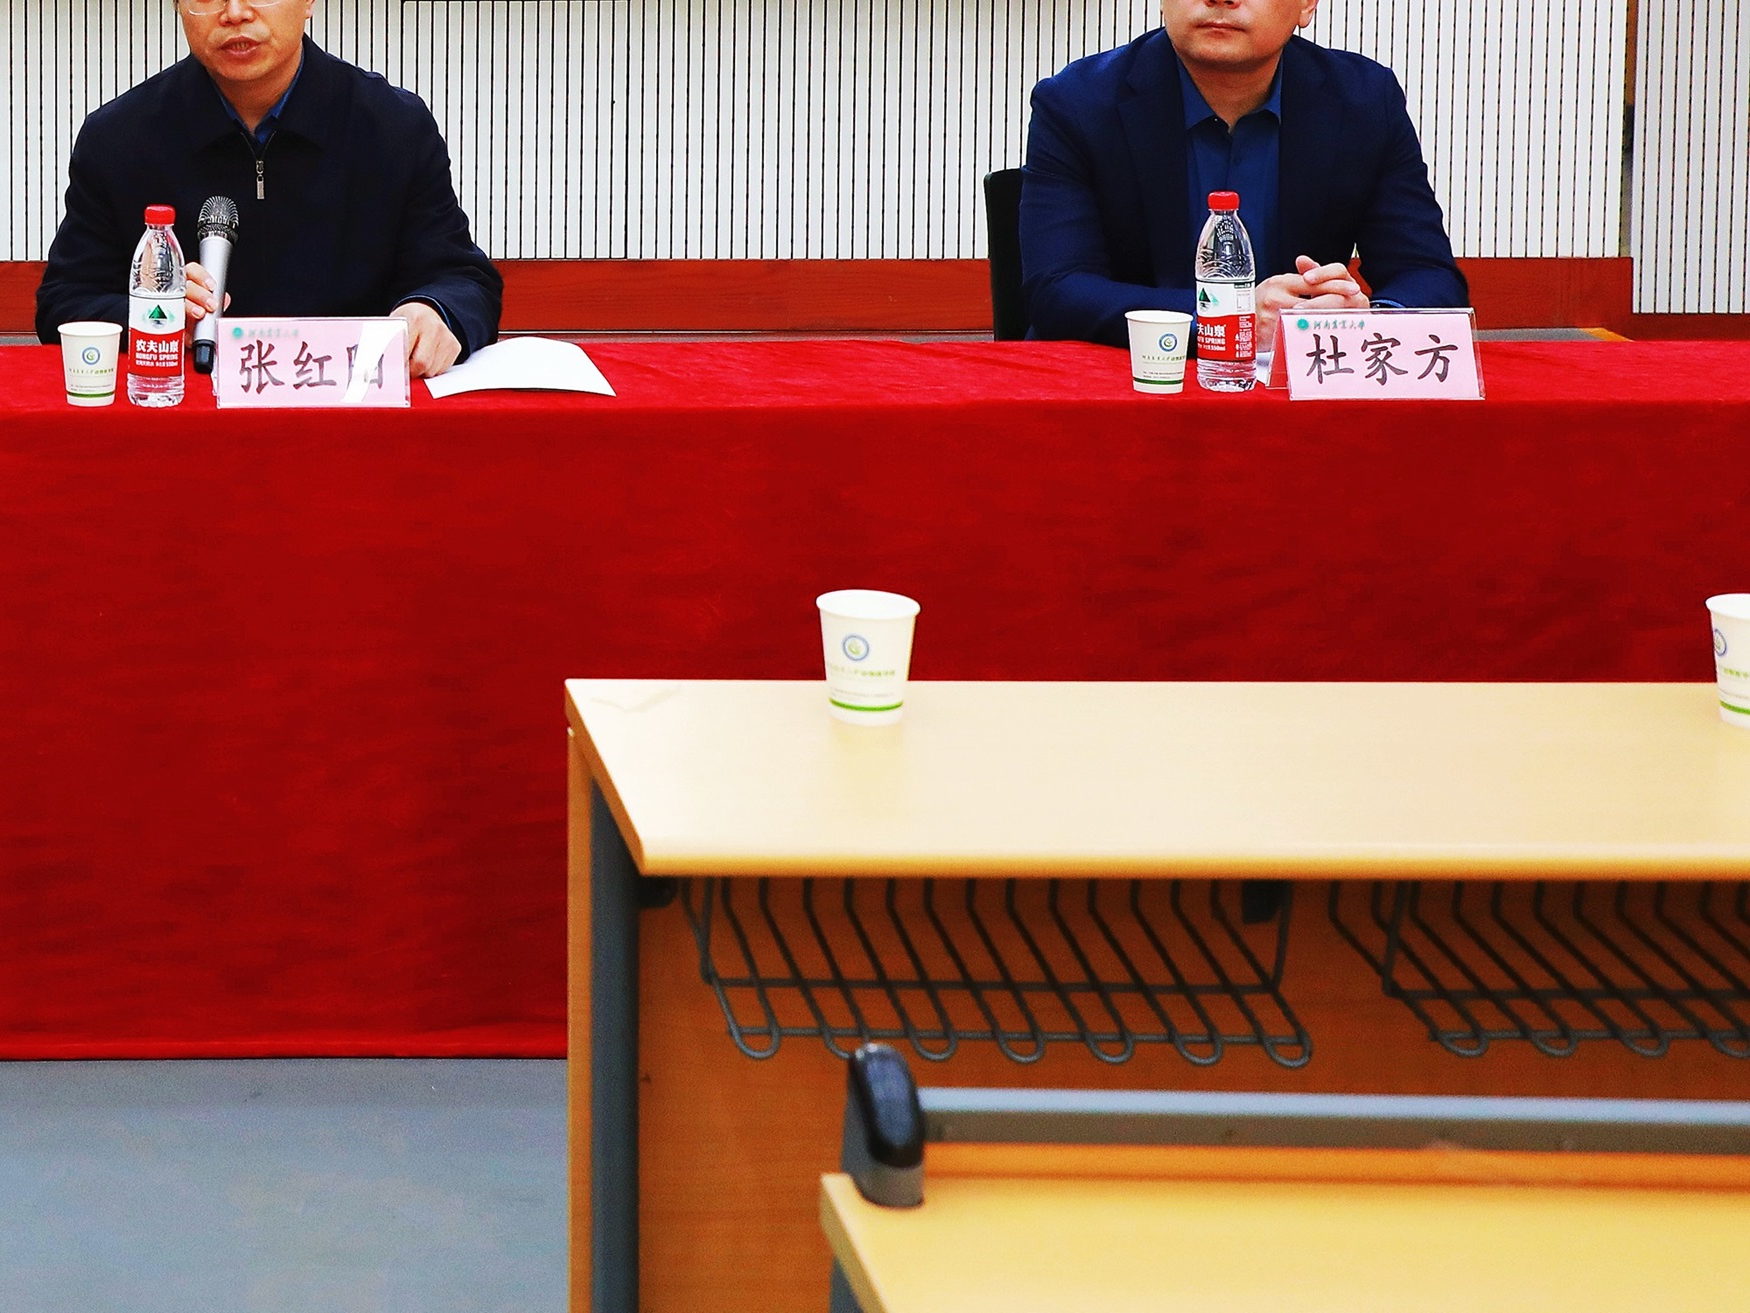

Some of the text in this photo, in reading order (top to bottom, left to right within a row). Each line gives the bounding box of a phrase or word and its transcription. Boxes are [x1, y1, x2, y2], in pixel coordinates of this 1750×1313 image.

[136, 339, 179, 353] 农夫山泉
[1305, 332, 1459, 386] 杜家方
